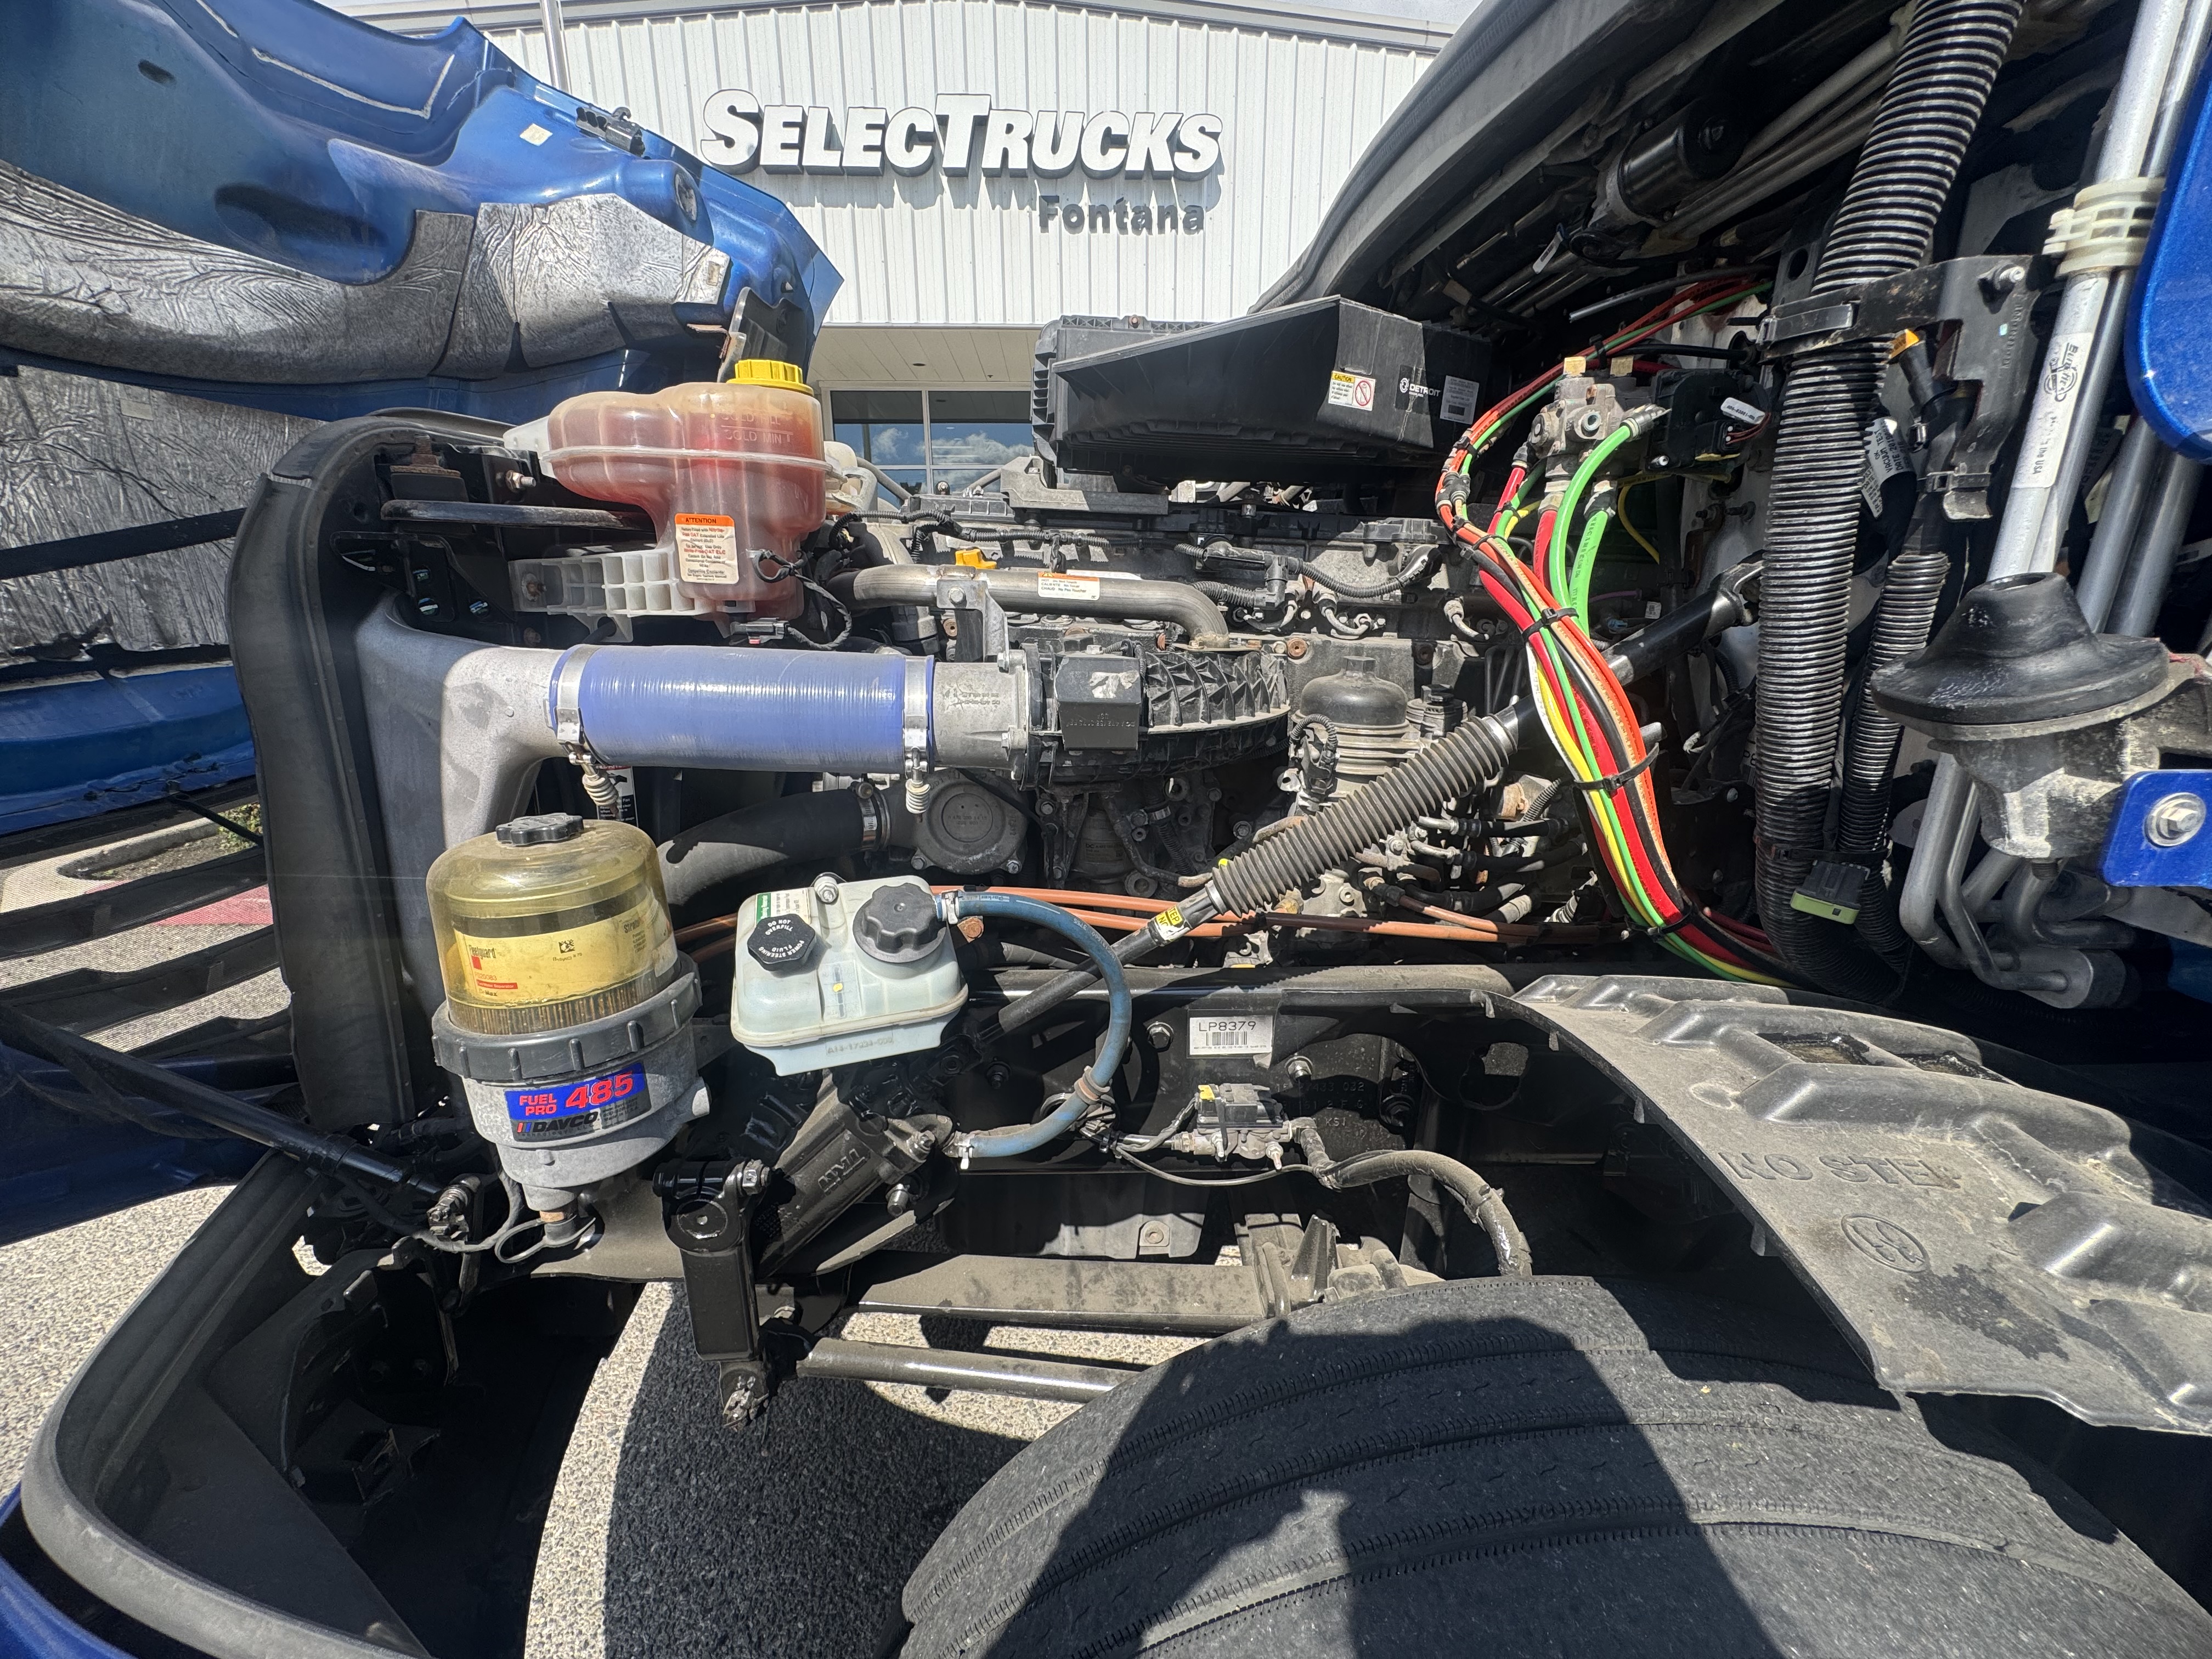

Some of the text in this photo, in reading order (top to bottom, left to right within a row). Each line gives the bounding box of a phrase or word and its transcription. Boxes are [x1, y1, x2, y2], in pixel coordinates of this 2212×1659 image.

[1038, 195, 1205, 234] Fontana
[1334, 374, 1352, 382] CAUTION
[1409, 383, 1441, 397] DETROIT
[763, 432, 782, 444] MIN
[1874, 429, 1884, 447] TEST
[1874, 449, 1881, 460] OK
[2032, 459, 2045, 474] USA
[765, 924, 793, 935] OVERFILL
[468, 944, 496, 960] Fleetguard
[758, 940, 805, 958] POWER STEERING
[771, 944, 793, 952] FLUID
[1199, 1021, 1256, 1032] LP8379
[519, 1093, 558, 1106] FUEL
[566, 1071, 634, 1109] 485
[525, 1104, 557, 1116] PRO
[532, 1111, 599, 1133] DAVCO
[1718, 1152, 1813, 1181] NO
